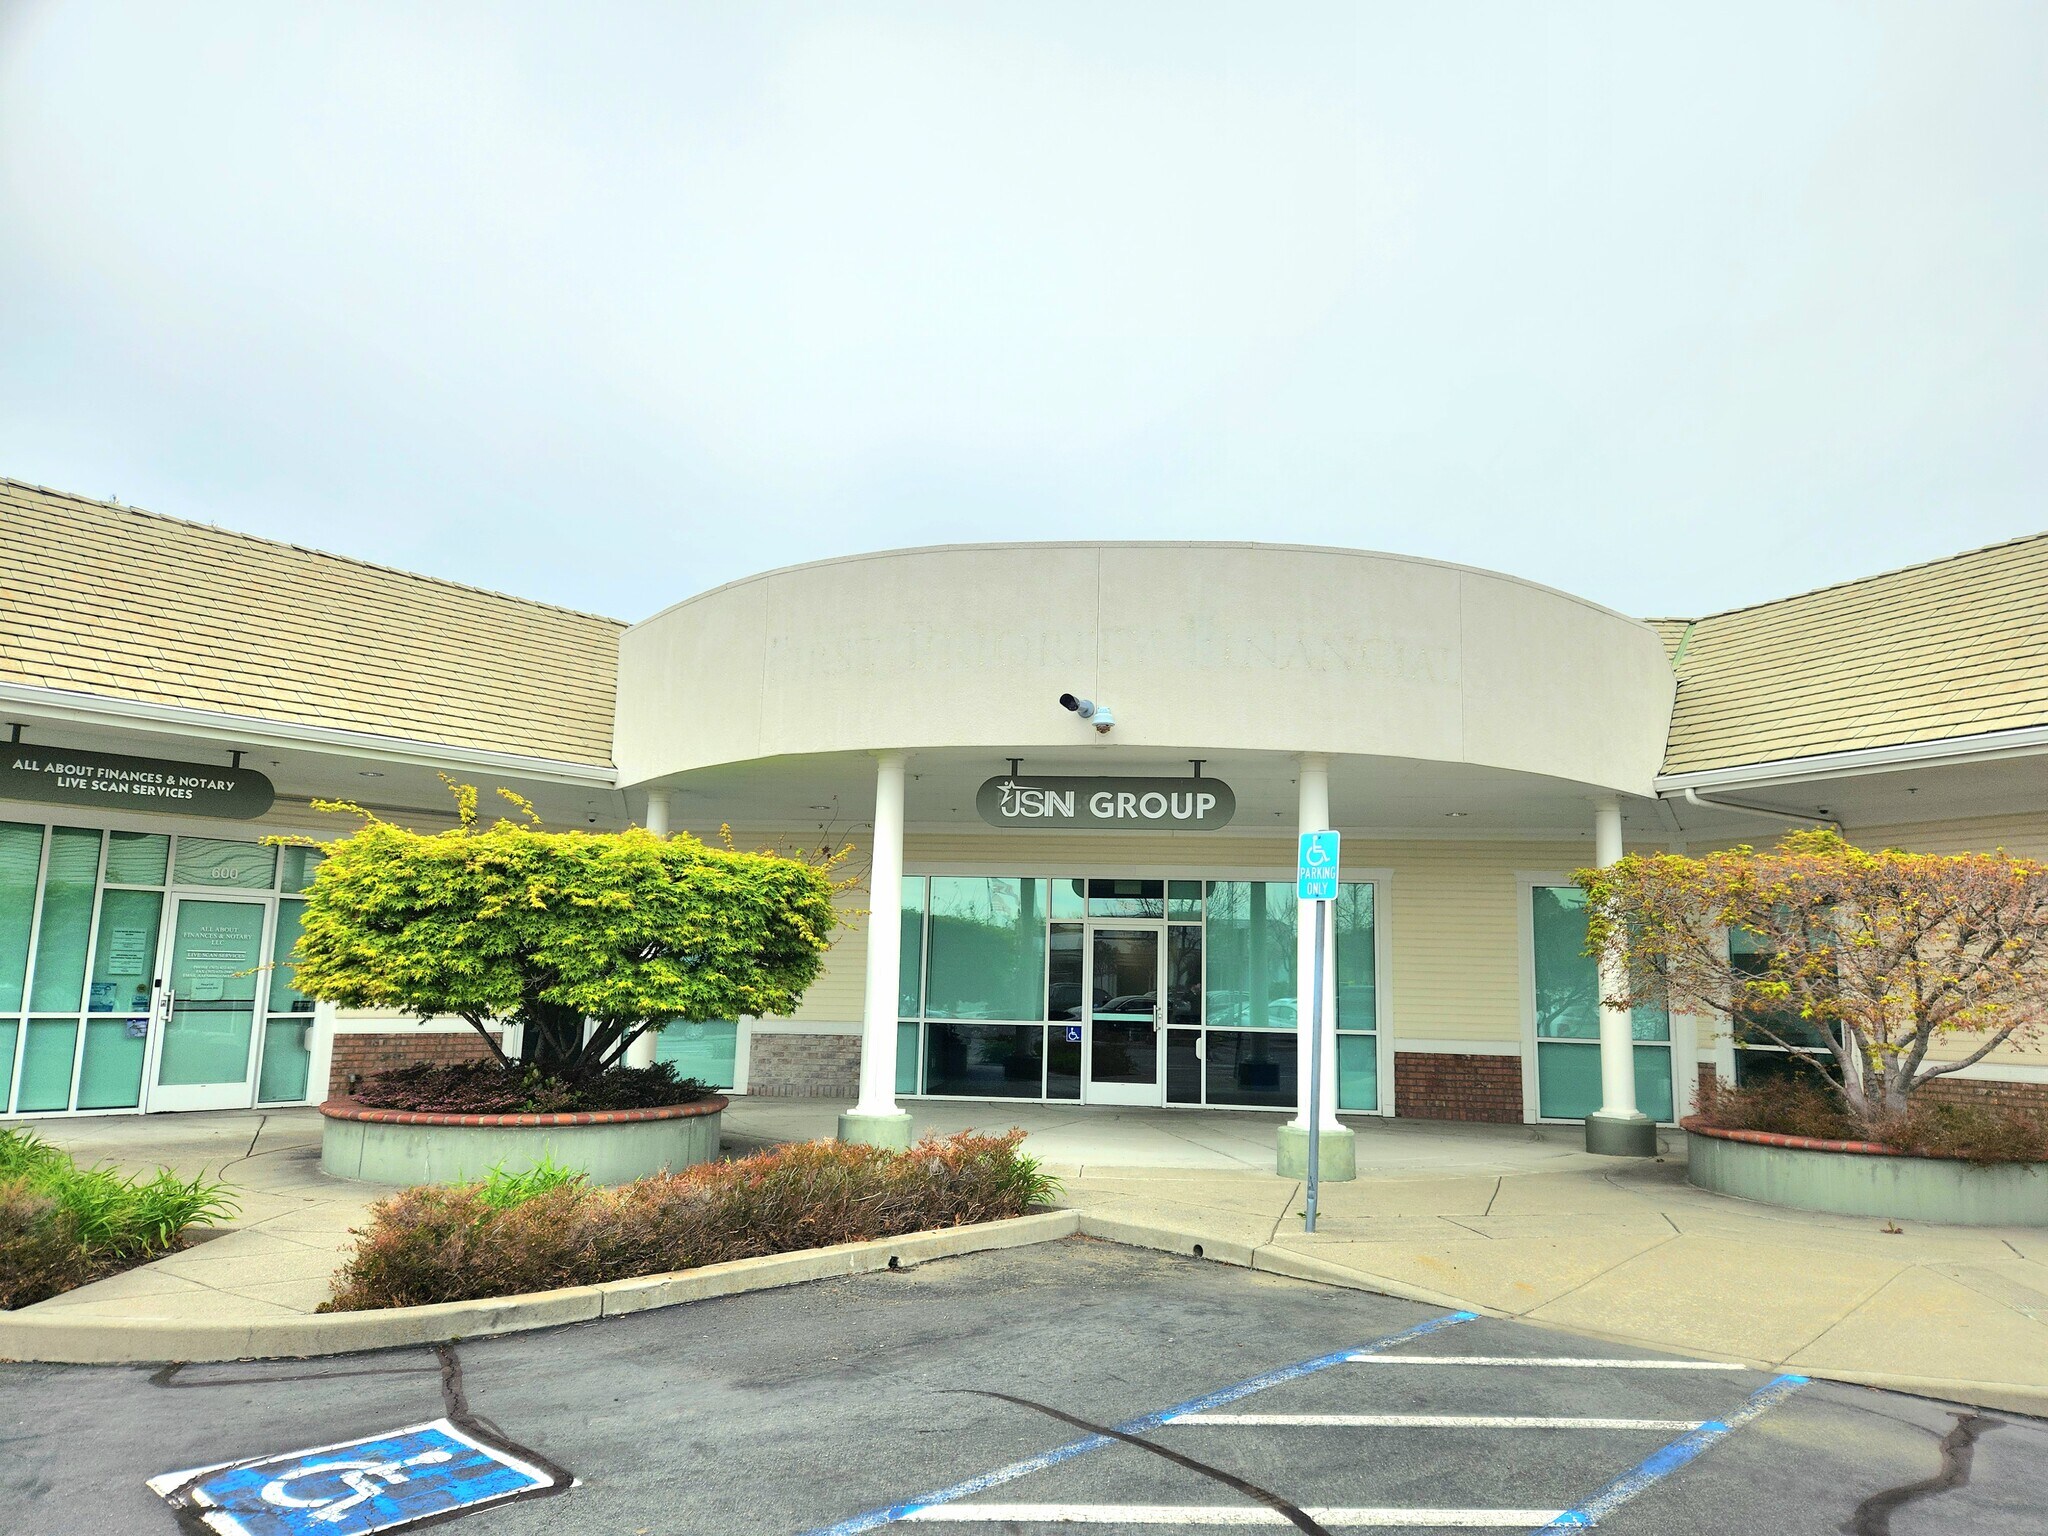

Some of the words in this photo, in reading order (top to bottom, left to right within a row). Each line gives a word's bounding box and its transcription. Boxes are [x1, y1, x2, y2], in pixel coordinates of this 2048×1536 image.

[12, 759, 40, 772] ALL
[44, 762, 94, 777] ABOUT
[97, 768, 163, 784] FINANCES
[166, 775, 176, 785] &
[179, 777, 235, 791] NOTARY
[57, 777, 87, 789] LIVE
[91, 780, 129, 793] SCAN
[132, 784, 193, 799] SERVICES
[1088, 791, 1217, 820] GROUP
[211, 867, 238, 879] 600
[1300, 866, 1336, 879] PARKING
[1307, 882, 1329, 895] ONLY
